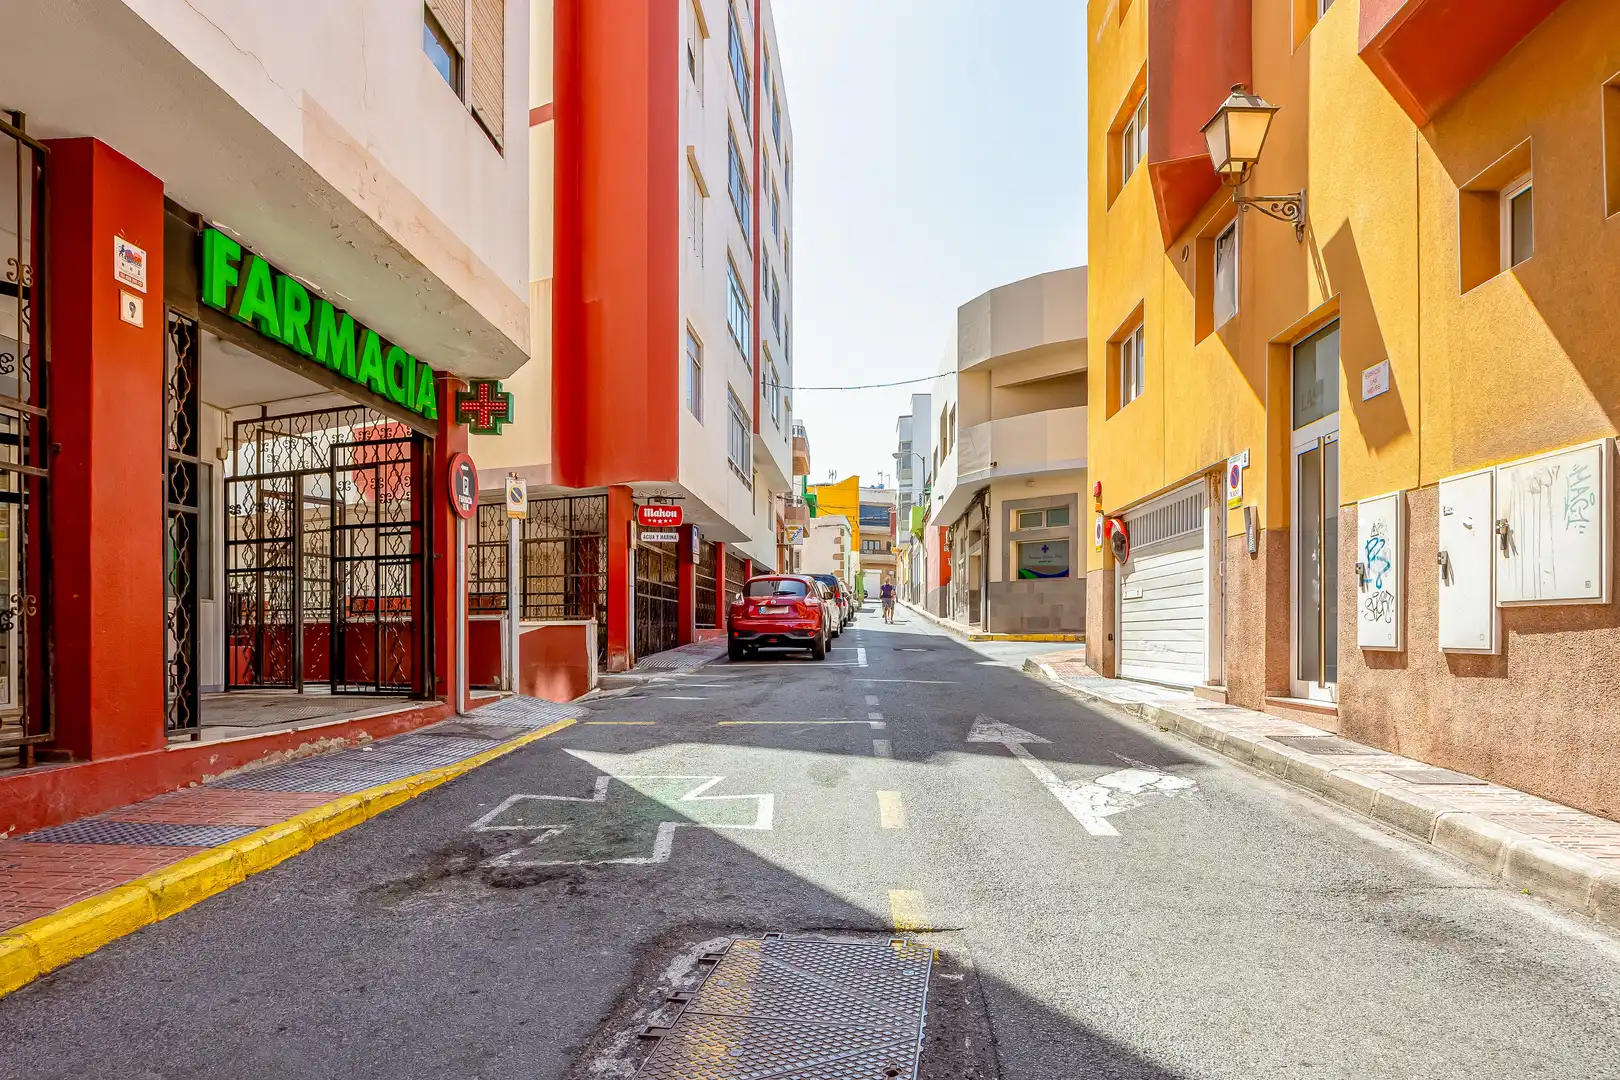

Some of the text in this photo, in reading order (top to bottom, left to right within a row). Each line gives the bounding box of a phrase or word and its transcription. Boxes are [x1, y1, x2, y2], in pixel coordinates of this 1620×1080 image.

[128, 301, 137, 318] 9
[203, 228, 438, 419] FARMACIA
[643, 508, 677, 518] Mahou
